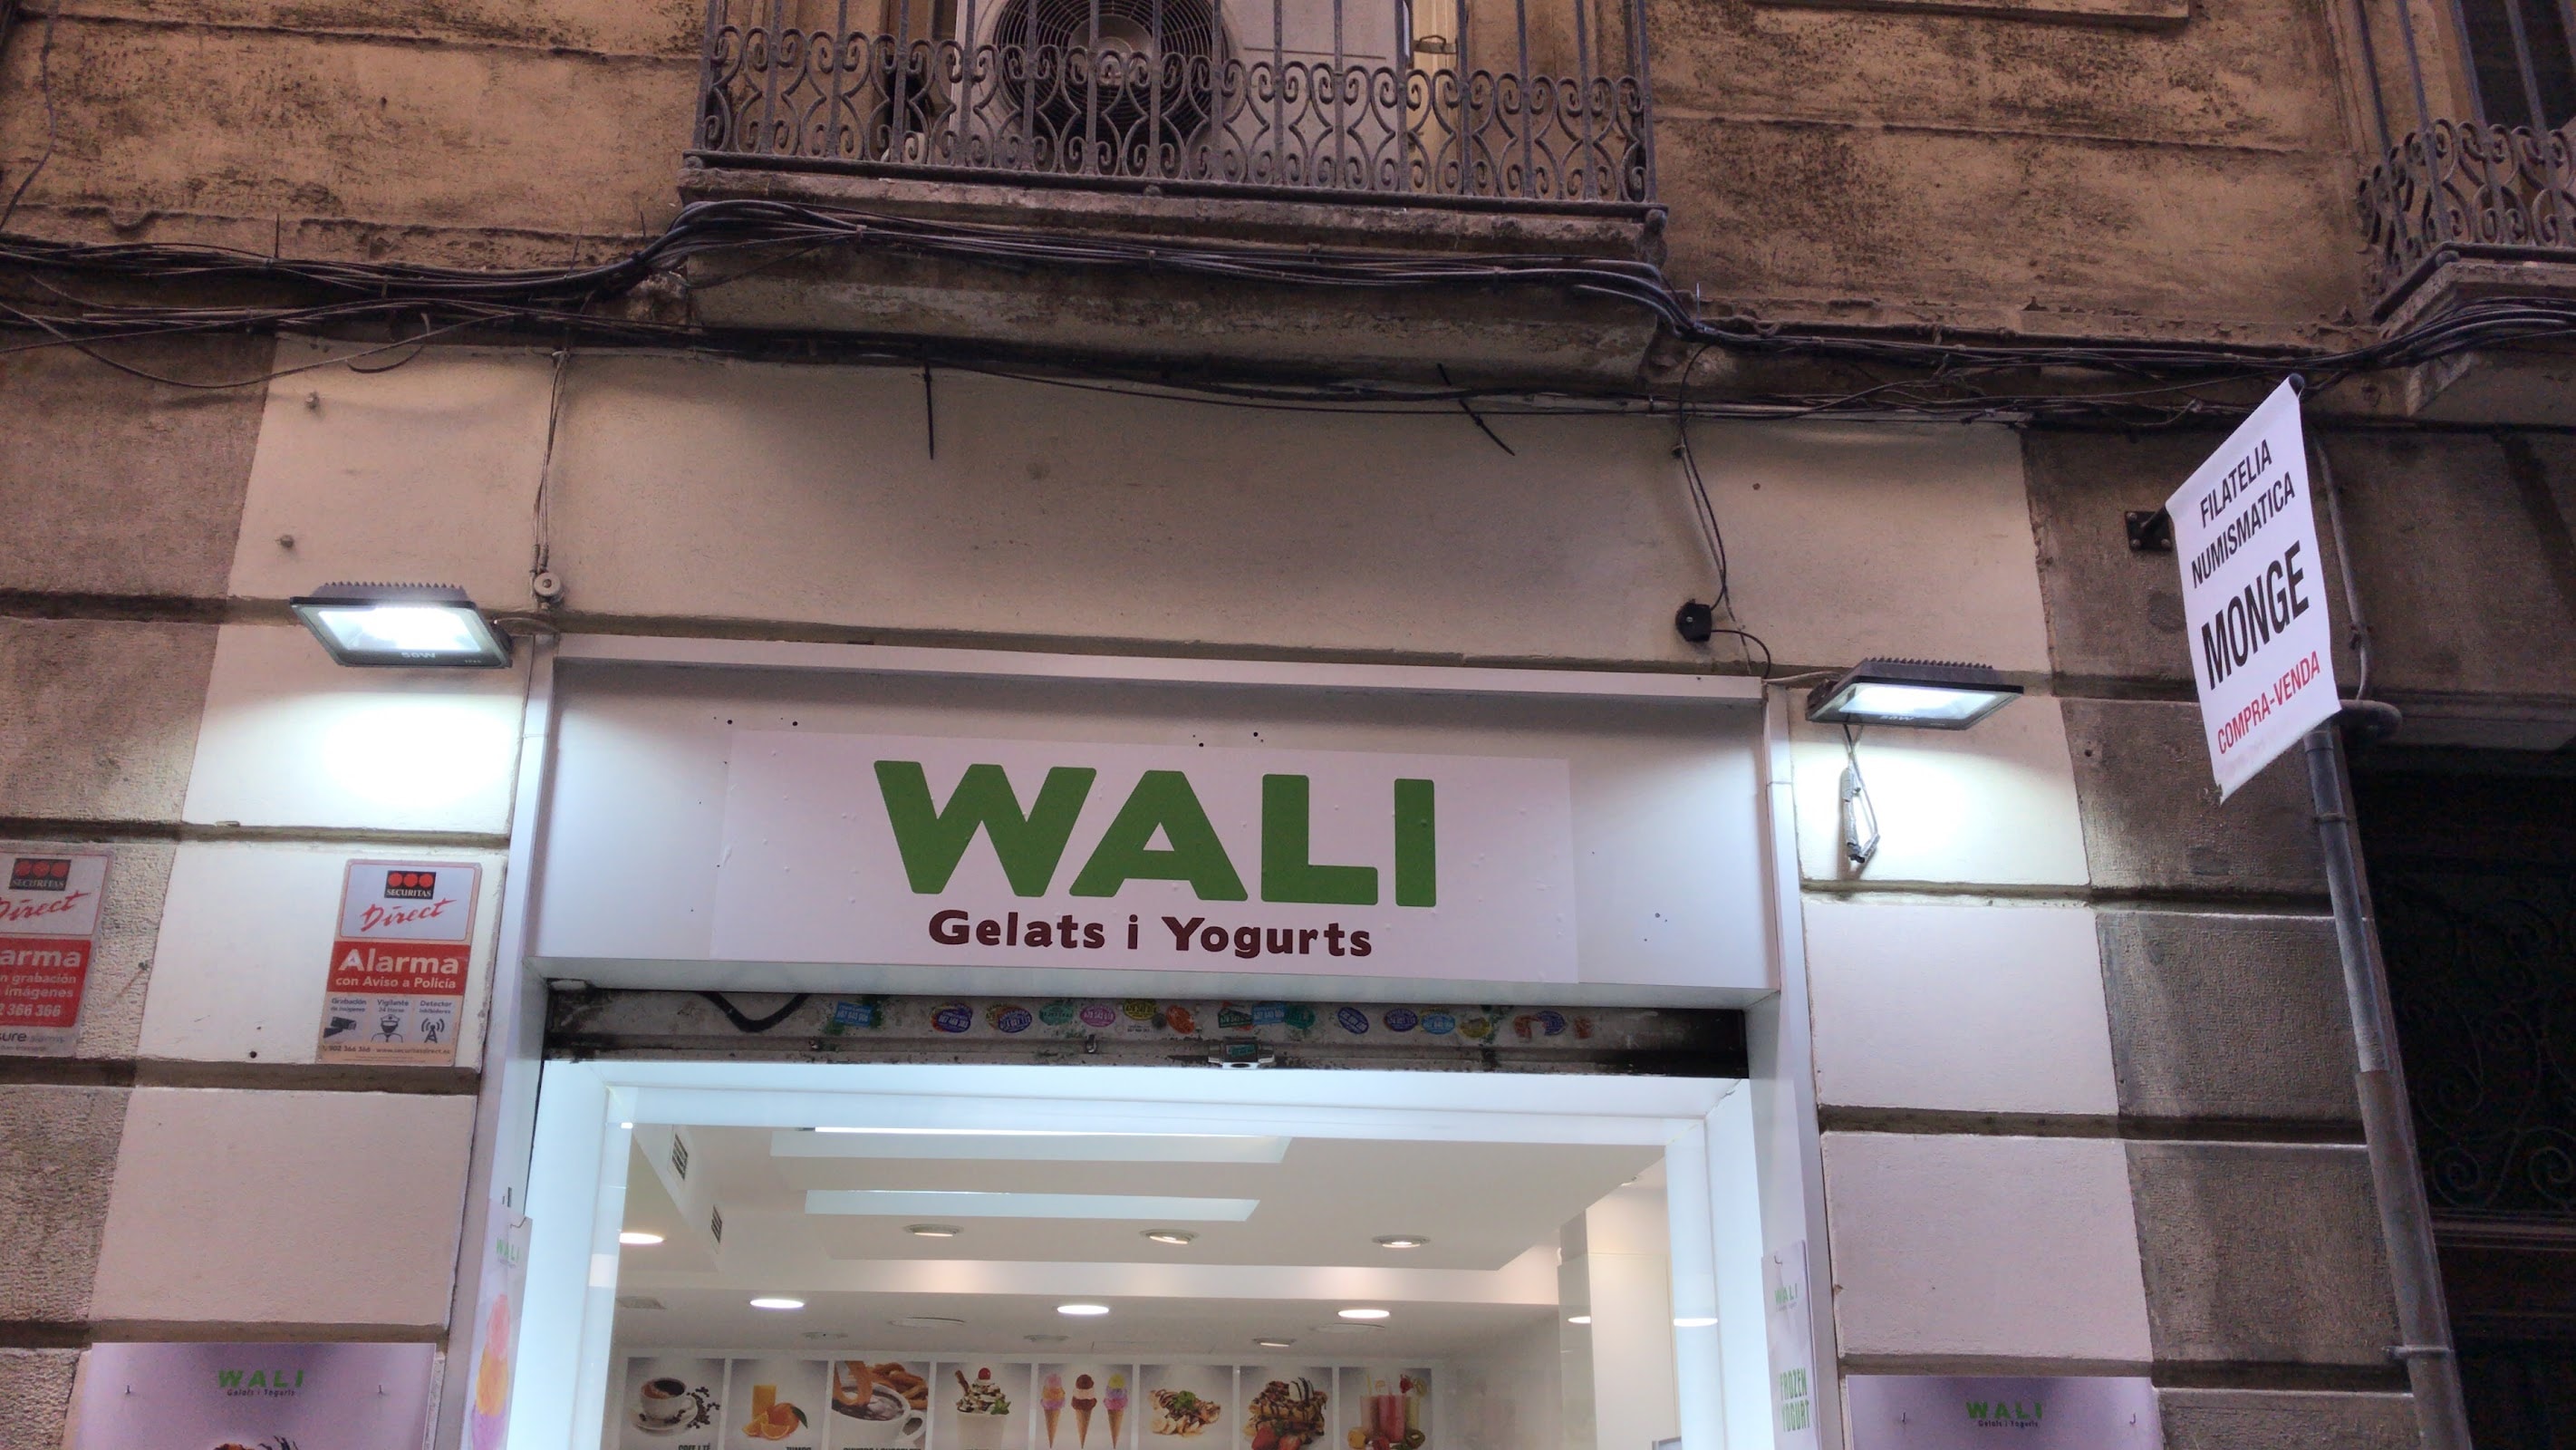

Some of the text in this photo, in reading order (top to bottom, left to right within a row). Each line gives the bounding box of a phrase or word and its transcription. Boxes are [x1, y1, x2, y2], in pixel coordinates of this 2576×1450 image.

[2200, 439, 2272, 528] FILATELIA
[2191, 471, 2295, 589] NUMISMATICA
[2201, 540, 2310, 691] MONGE
[2217, 650, 2320, 755] COMPRA-VENDA
[873, 759, 1437, 907] WALI
[12, 878, 64, 888] SECURITAS
[386, 888, 431, 897] SECURITAS
[360, 898, 457, 932] Direct
[929, 909, 1373, 958] Gelats i Yogurts
[338, 948, 459, 974] Alarma
[335, 977, 359, 986] con
[362, 976, 399, 987] Aviso
[402, 980, 410, 988] a
[420, 1000, 452, 1008] Detector
[1774, 1283, 1799, 1305] WALI
[218, 1369, 304, 1387] WALI
[1780, 1368, 1808, 1401] FROZEN
[1781, 1399, 1810, 1432] YOGURT
[1965, 1401, 2042, 1419] WALI
